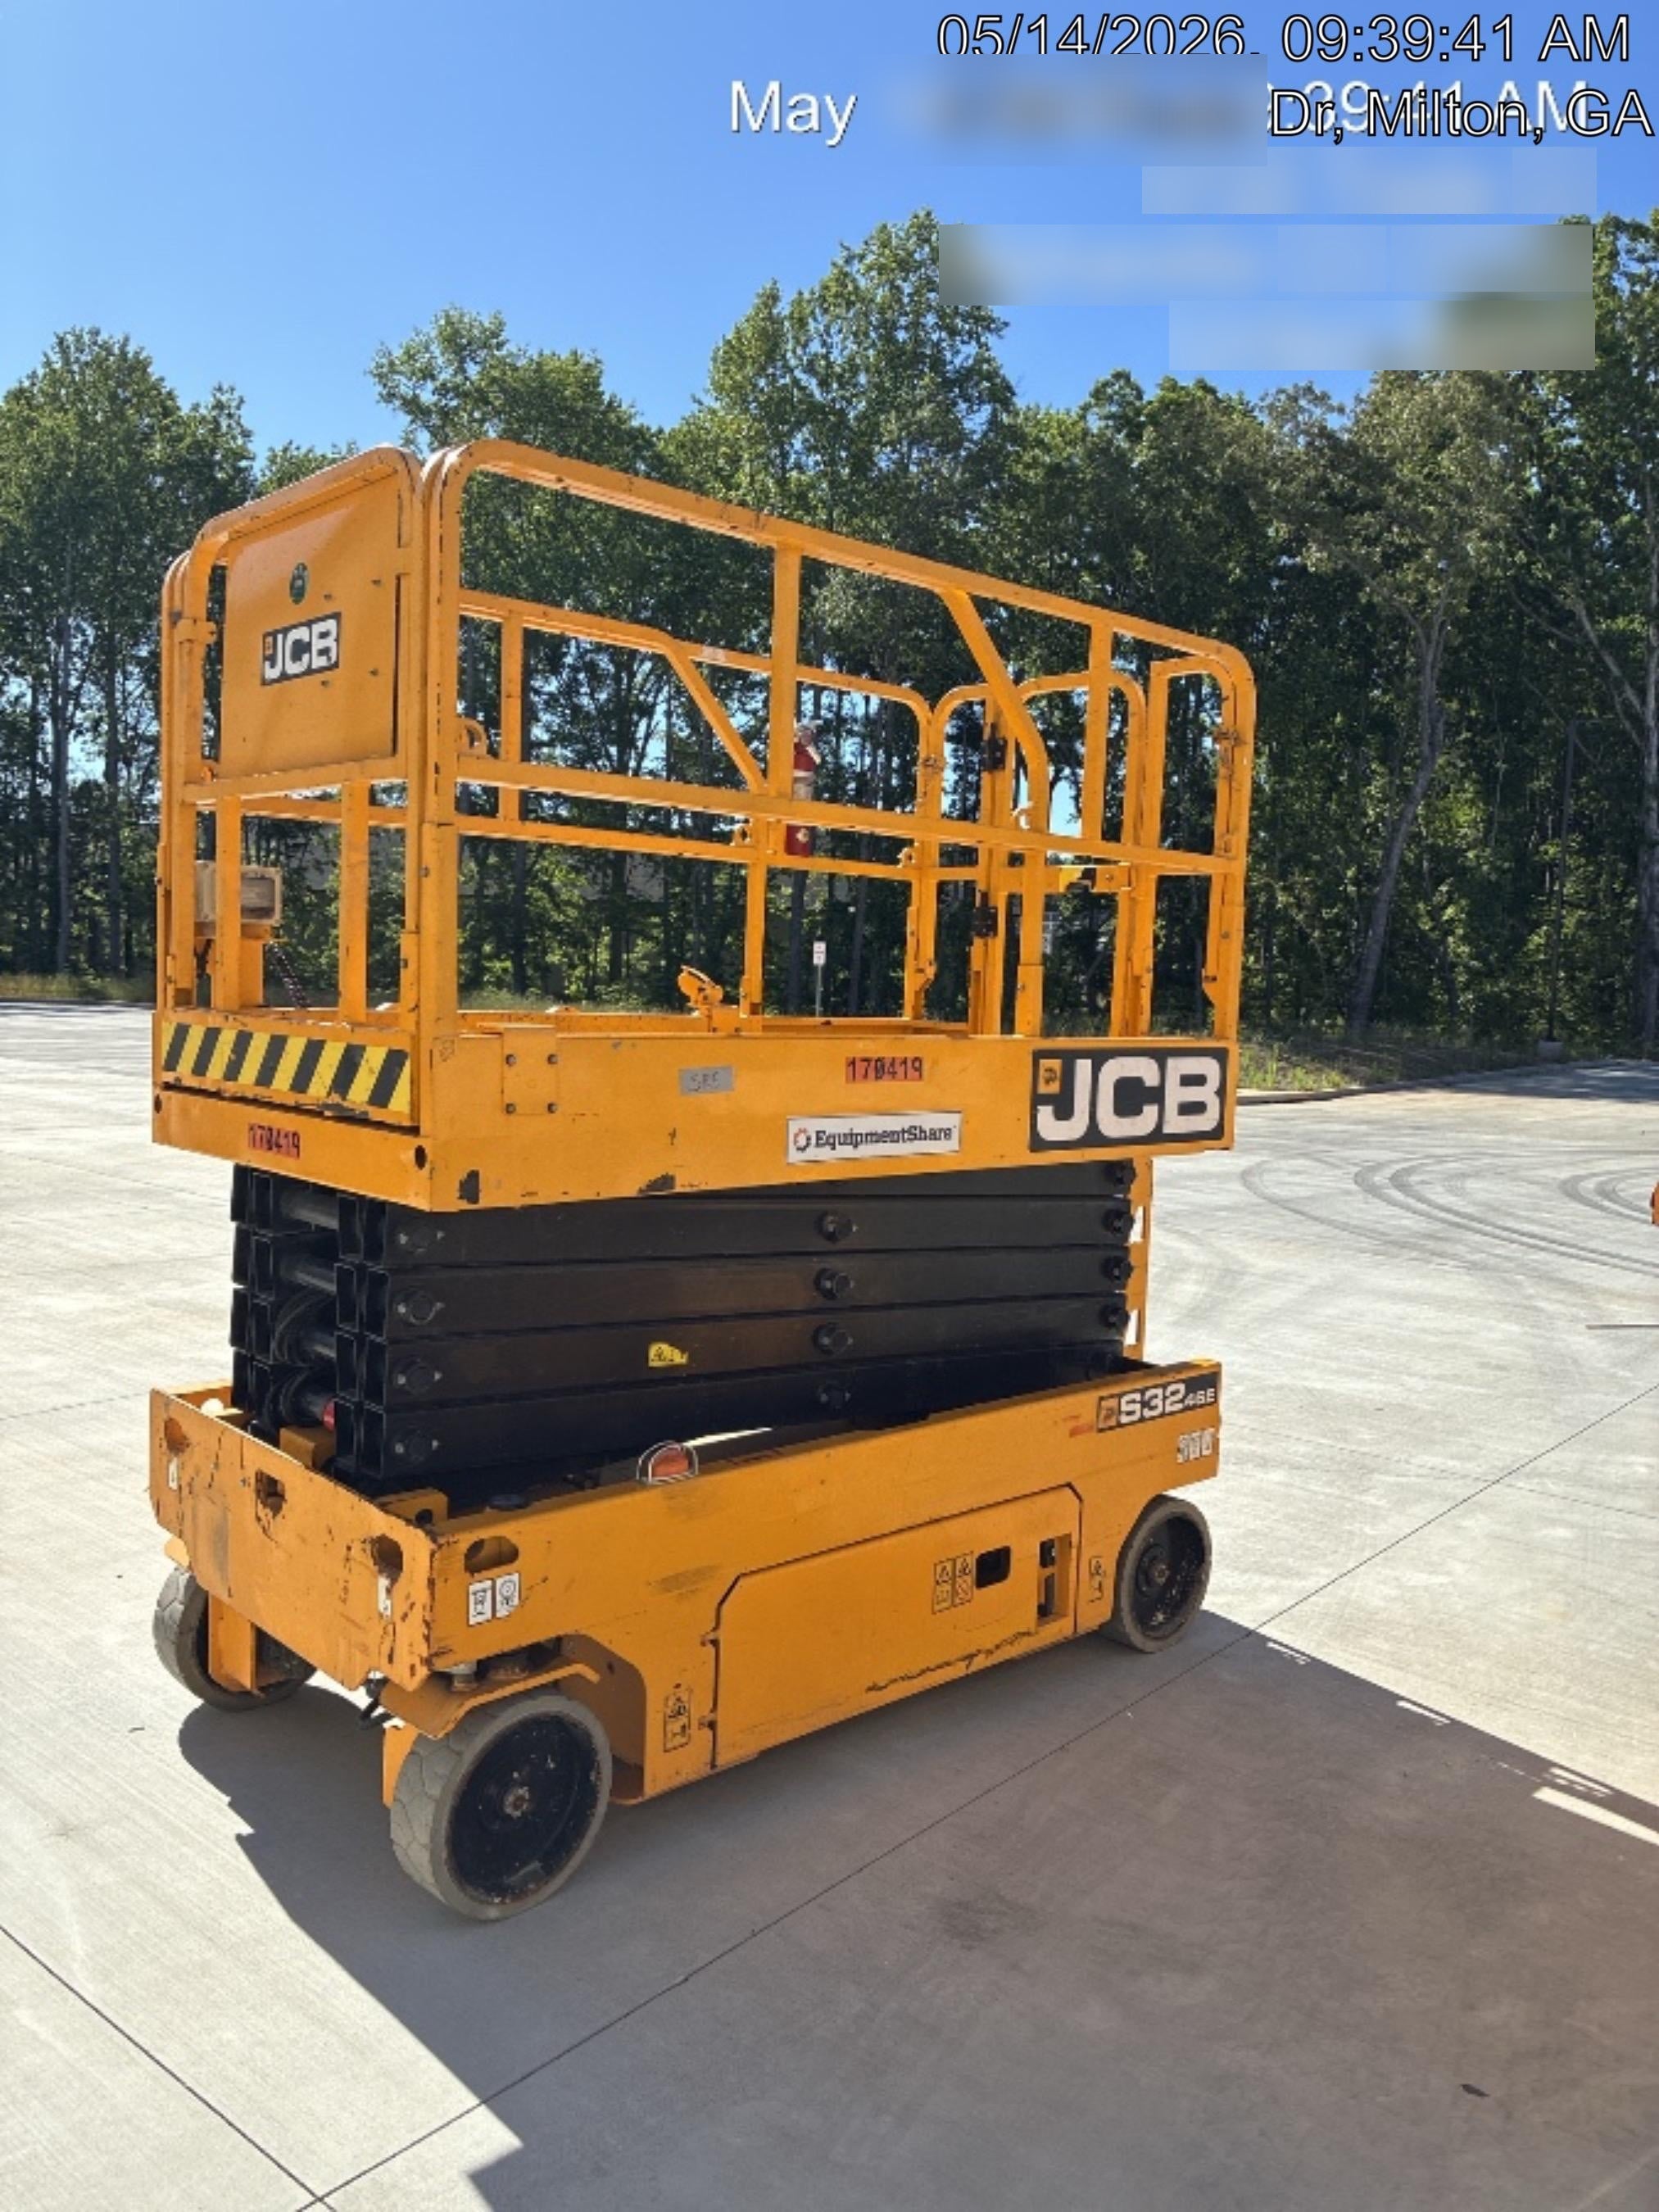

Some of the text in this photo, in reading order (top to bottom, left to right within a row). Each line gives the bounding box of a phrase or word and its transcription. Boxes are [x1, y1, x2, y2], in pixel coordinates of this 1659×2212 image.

[264, 619, 338, 679] JCB
[847, 1056, 923, 1082] 170419
[1036, 1056, 1221, 1141] JCB
[814, 1125, 953, 1150] EquipmentShare
